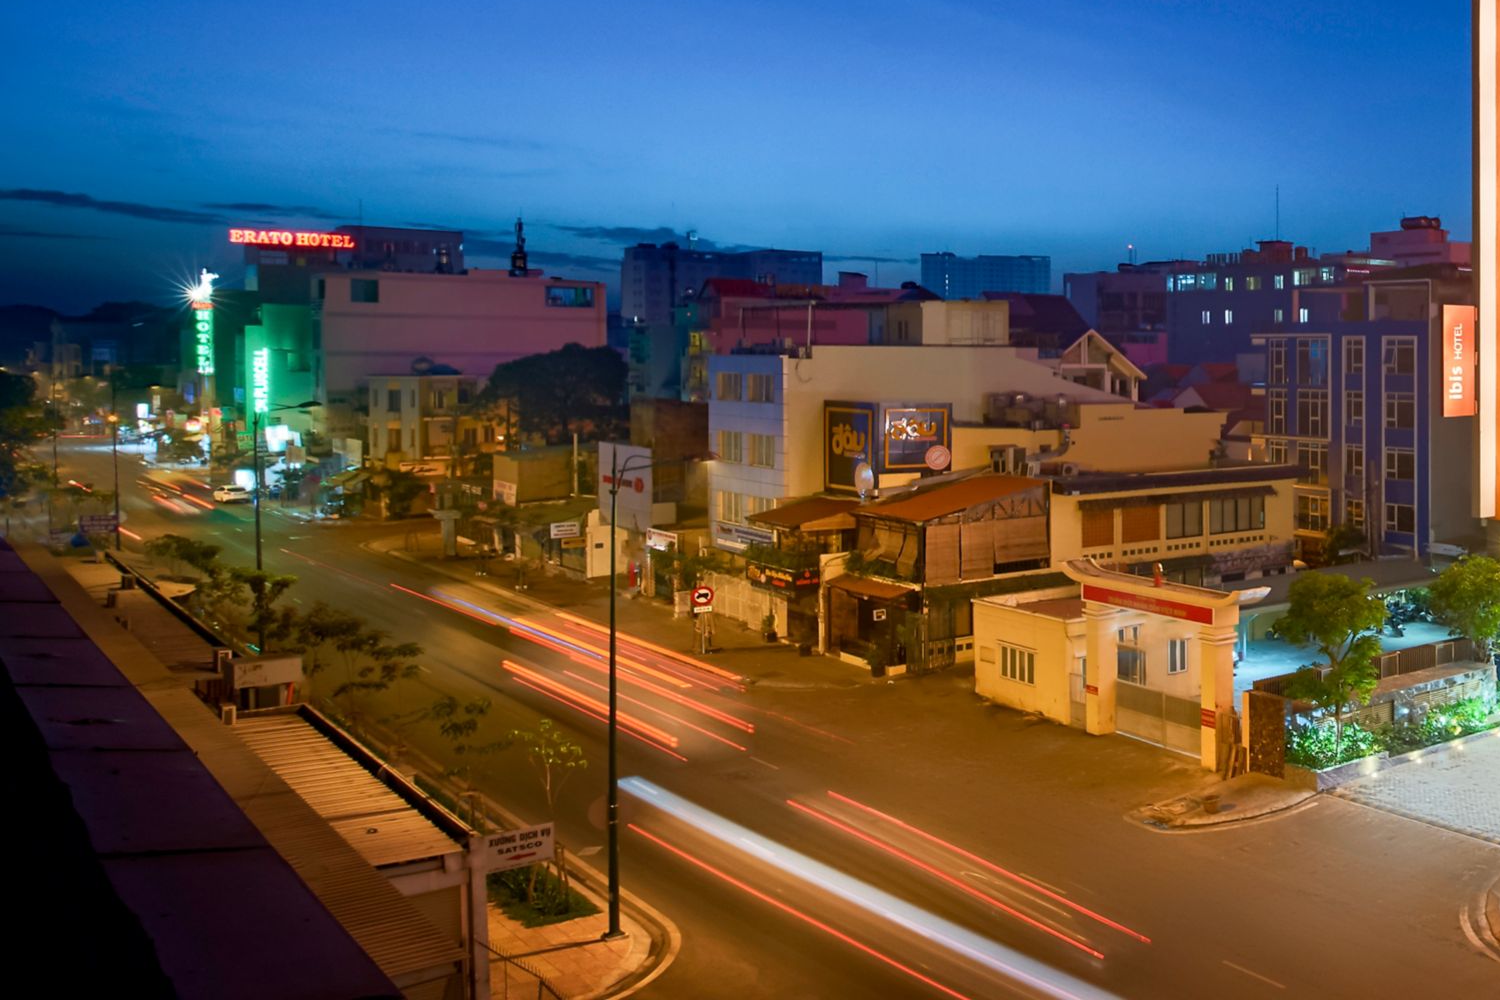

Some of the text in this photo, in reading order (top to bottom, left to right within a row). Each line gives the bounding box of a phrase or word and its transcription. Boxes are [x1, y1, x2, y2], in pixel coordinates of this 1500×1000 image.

[229, 229, 355, 248] ERATO HOTEL
[1449, 323, 1463, 400] ibis HOTEL
